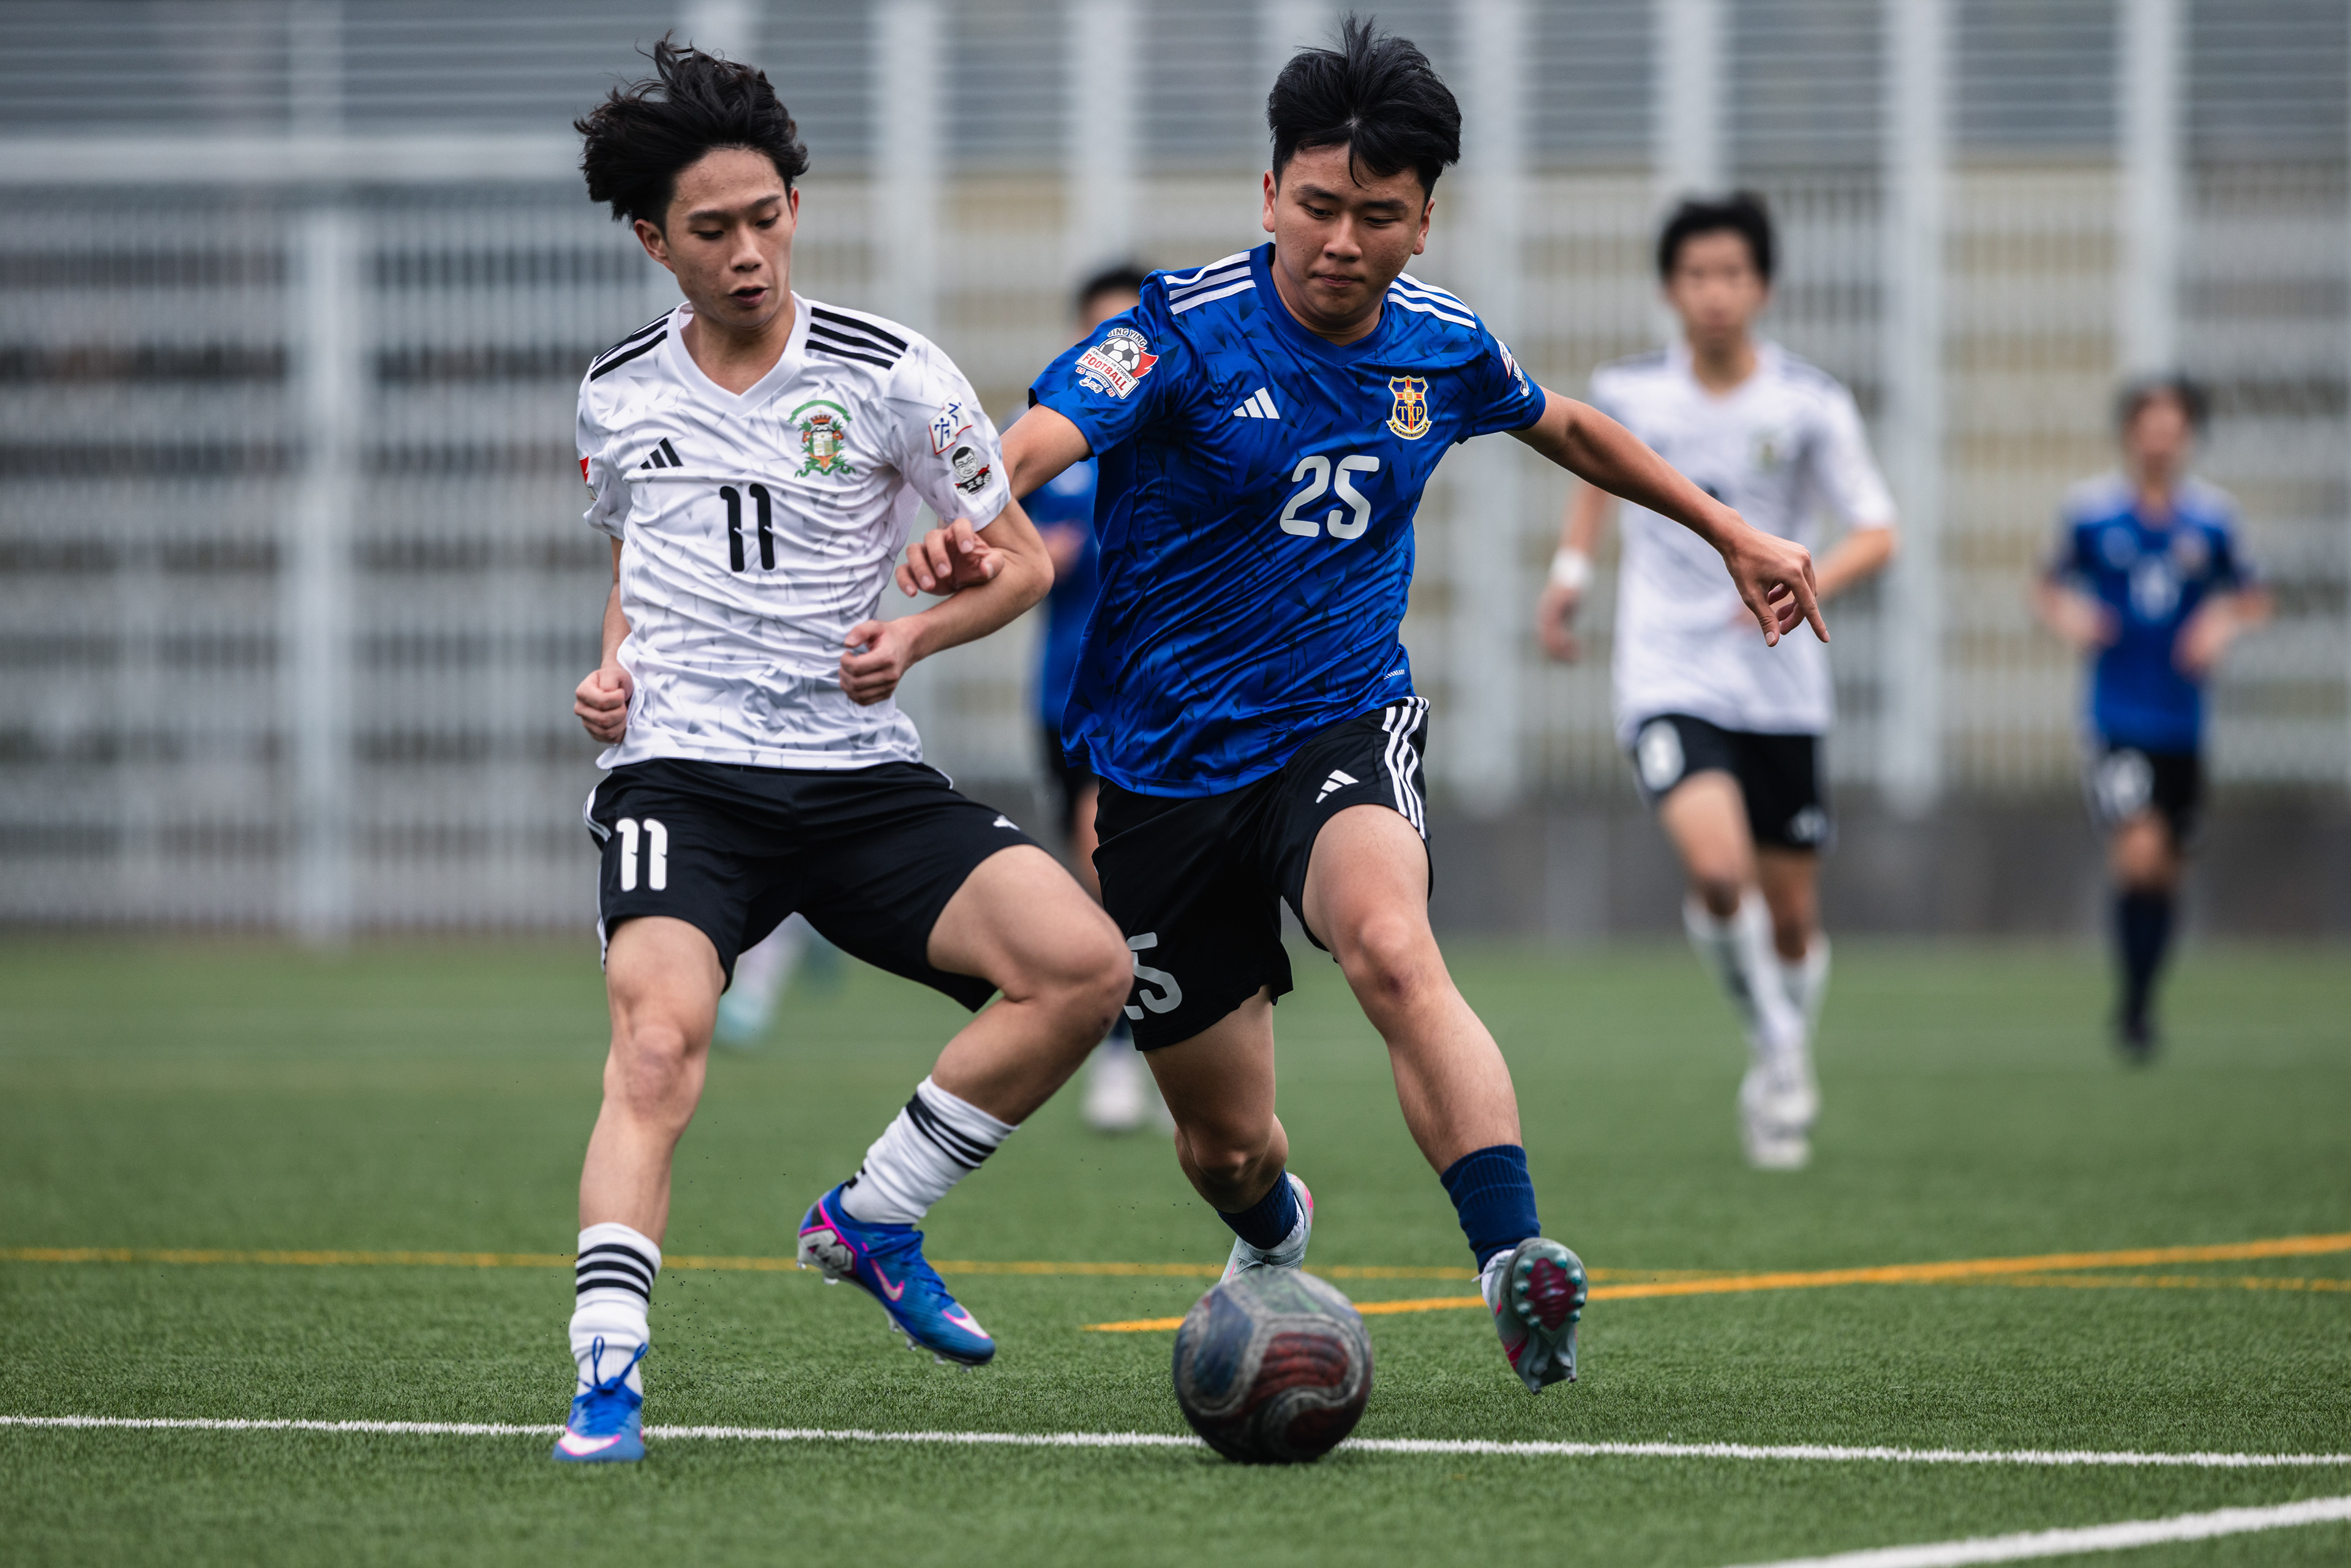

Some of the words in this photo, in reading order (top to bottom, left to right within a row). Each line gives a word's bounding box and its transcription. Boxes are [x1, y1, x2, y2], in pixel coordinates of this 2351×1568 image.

[1108, 328, 1128, 337] JING
[1130, 330, 1147, 347] YING
[1082, 353, 1127, 391] FOOTBALL
[1086, 371, 1109, 388] TOURNAMENT
[1116, 366, 1133, 383] SCHOOLS
[1397, 405, 1423, 421] TKP
[1280, 455, 1379, 539] 25
[719, 482, 774, 572] 11
[615, 817, 668, 892] 11
[1123, 932, 1182, 1020] 5
